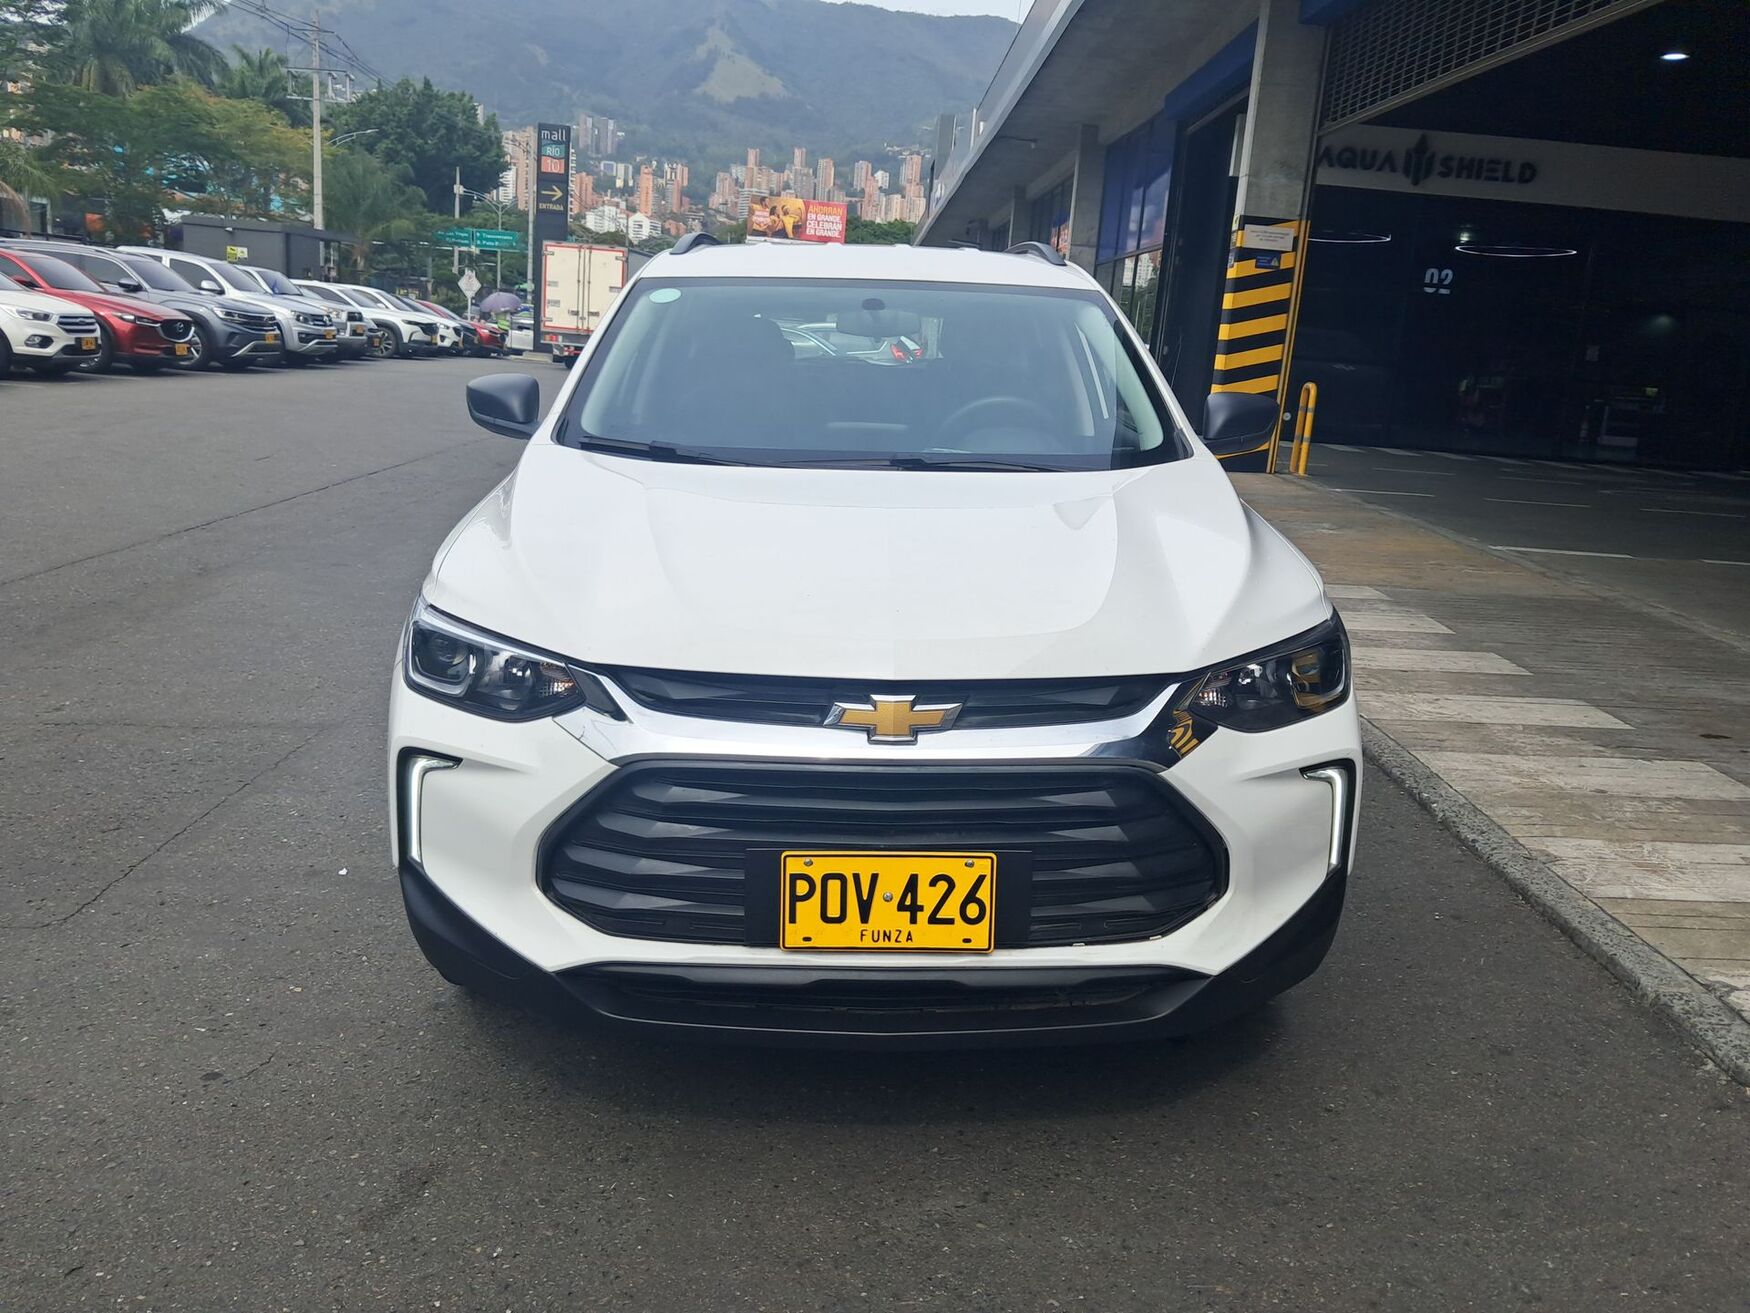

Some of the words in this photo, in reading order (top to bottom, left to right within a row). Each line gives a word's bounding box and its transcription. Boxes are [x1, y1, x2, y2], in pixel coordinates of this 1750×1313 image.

[541, 129, 566, 141] mall
[547, 159, 560, 173] 10
[1318, 145, 1398, 173] AQUA
[1438, 154, 1538, 184] SHIELD
[806, 219, 843, 232] CELEBRAN
[1423, 268, 1454, 295] 02
[788, 872, 879, 925] POV
[896, 873, 987, 926] 426
[860, 929, 913, 943] FUNZA
